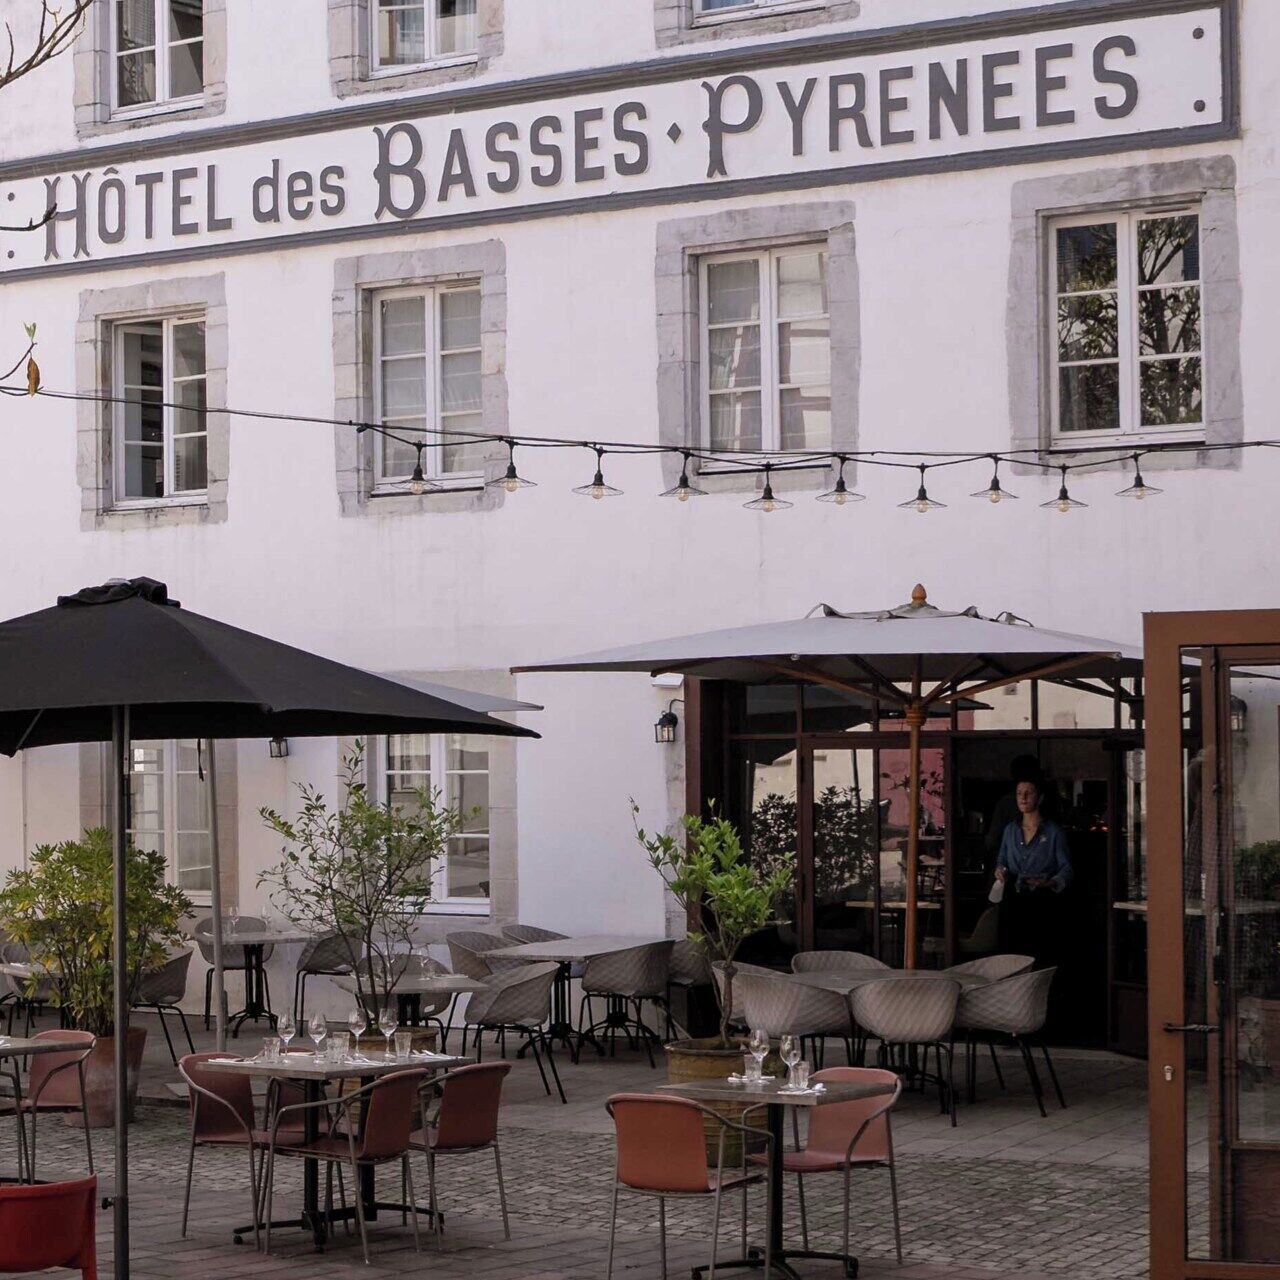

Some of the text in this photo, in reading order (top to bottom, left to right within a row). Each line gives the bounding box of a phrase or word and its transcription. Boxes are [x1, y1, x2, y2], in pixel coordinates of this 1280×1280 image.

[43, 34, 1139, 262] HÔTEL des BASSES PYRENEES
